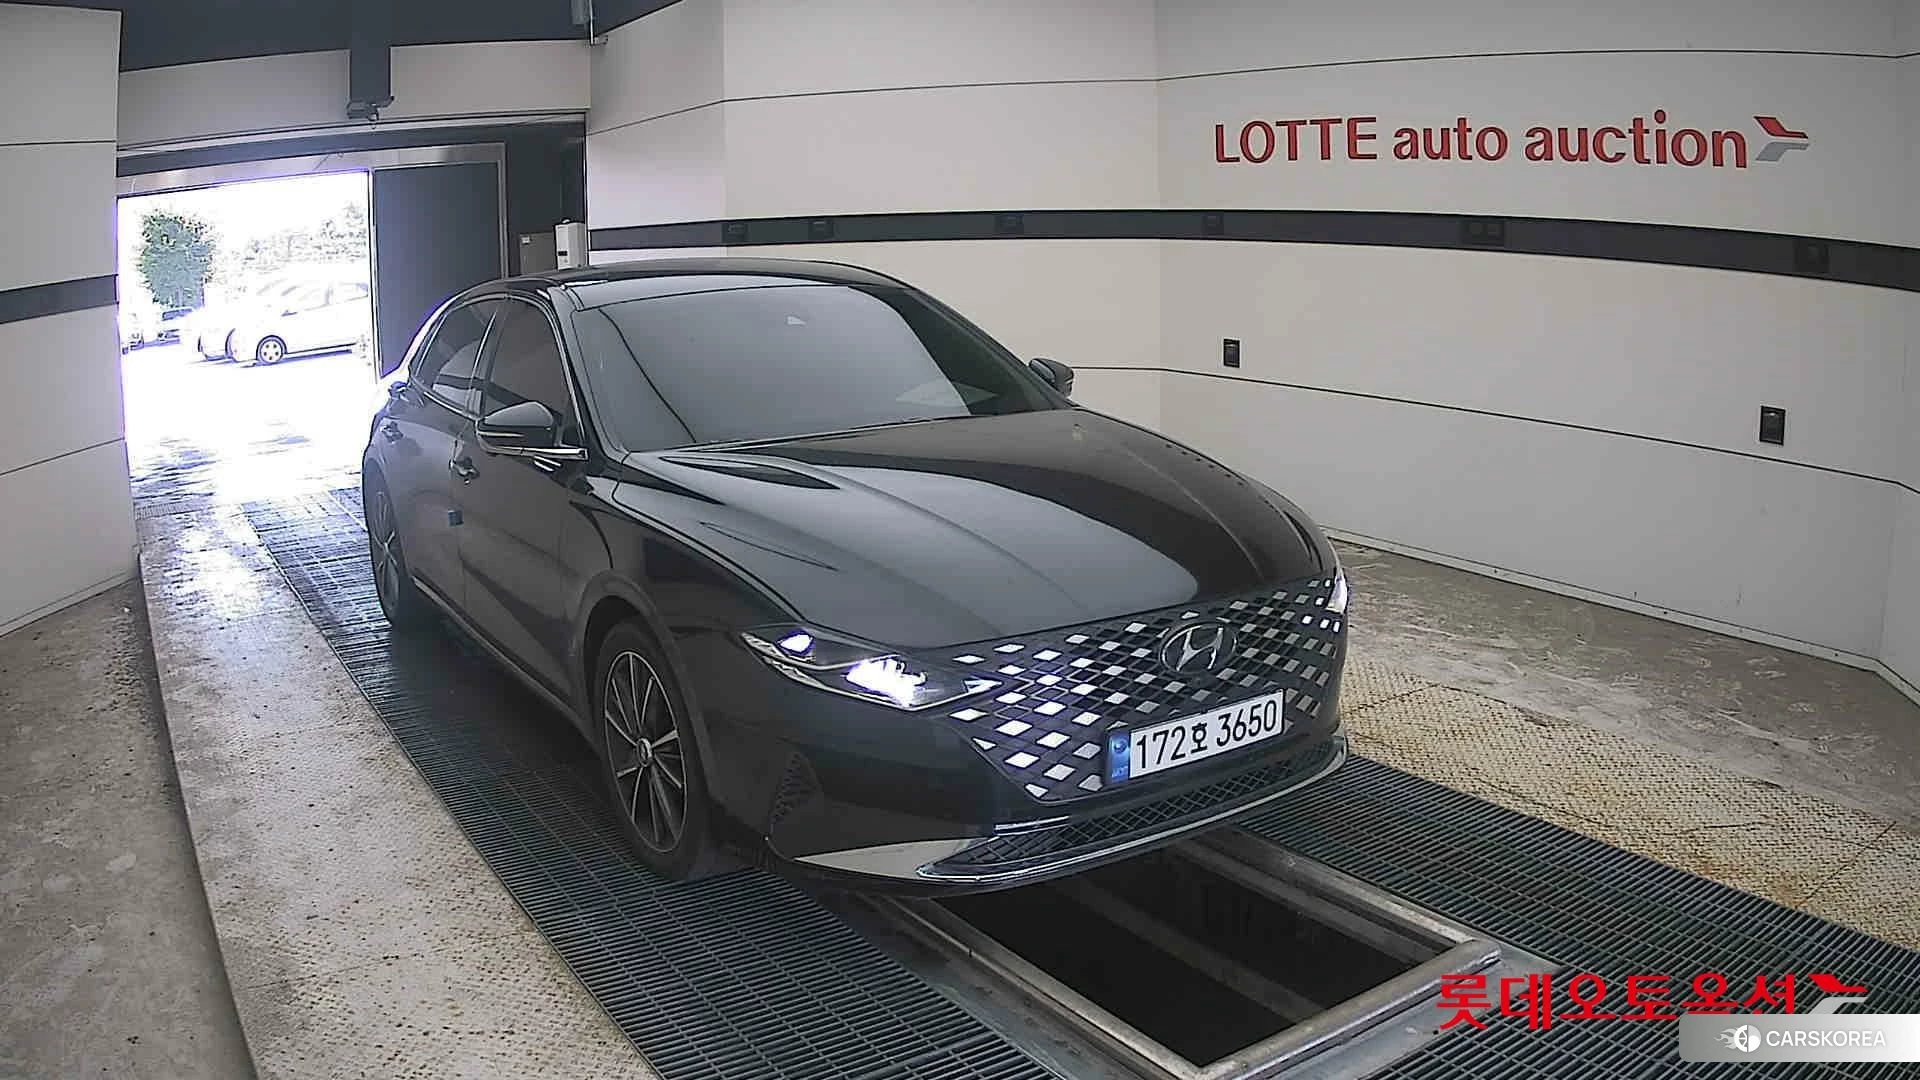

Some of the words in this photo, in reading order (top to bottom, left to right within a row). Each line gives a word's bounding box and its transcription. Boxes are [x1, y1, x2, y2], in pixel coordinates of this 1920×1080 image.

[1215, 116, 1378, 164] LOTTE
[1393, 117, 1509, 161] auto
[1524, 109, 1748, 169] auction
[1136, 722, 1209, 769] 172호
[1216, 700, 1278, 747] 3650
